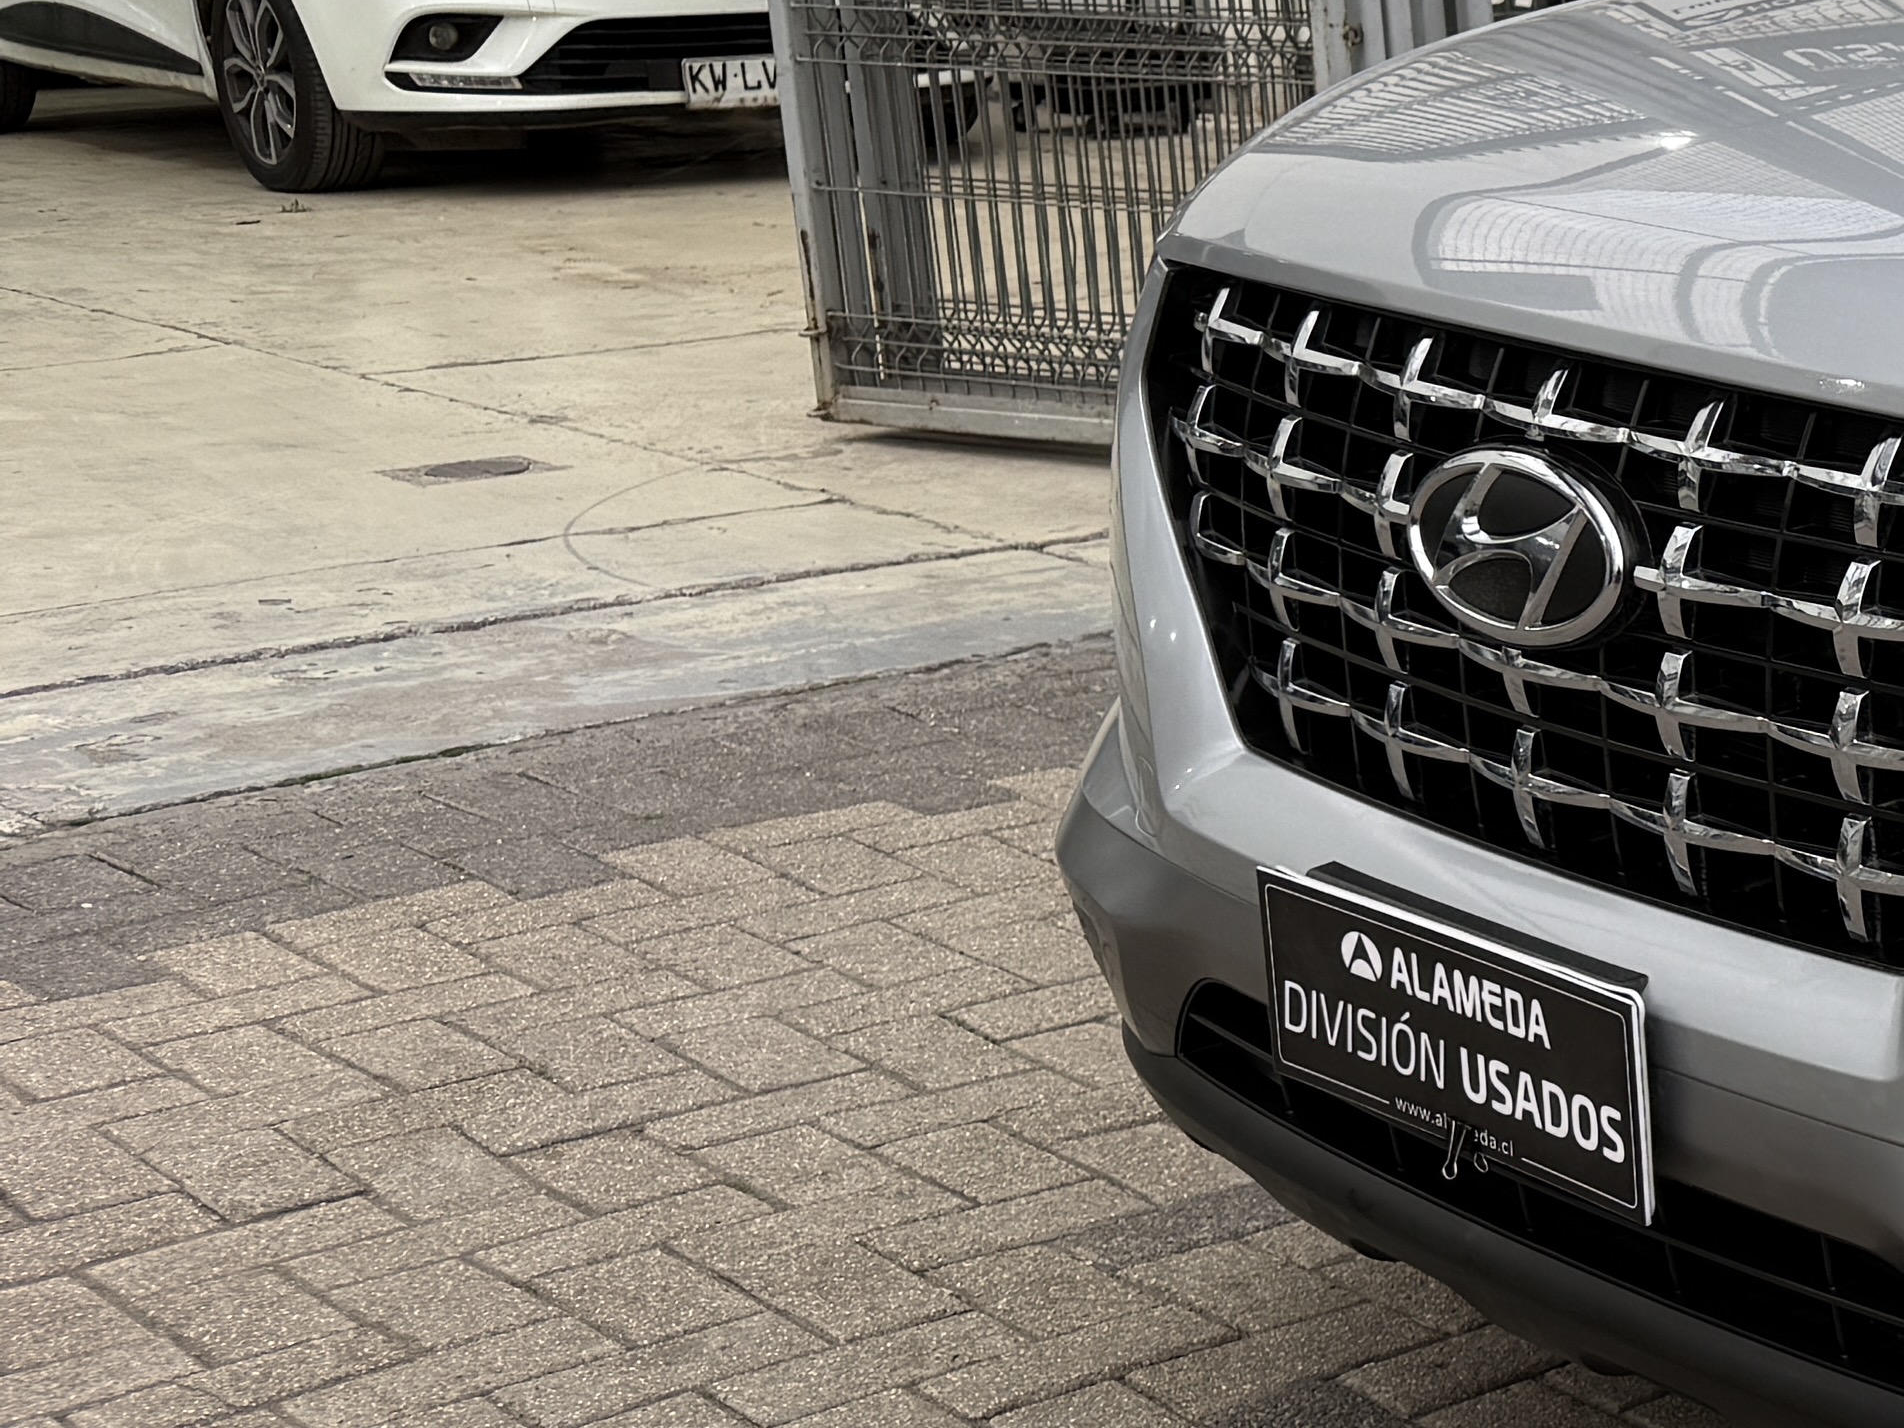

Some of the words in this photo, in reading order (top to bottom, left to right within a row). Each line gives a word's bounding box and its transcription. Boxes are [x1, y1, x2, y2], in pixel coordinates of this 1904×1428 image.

[1390, 946, 1553, 1051] ALAMEDA
[1283, 979, 1447, 1091] DIVISIÓN
[1459, 1046, 1626, 1165] USADOS
[1395, 1096, 1515, 1158] www.alda.cl
